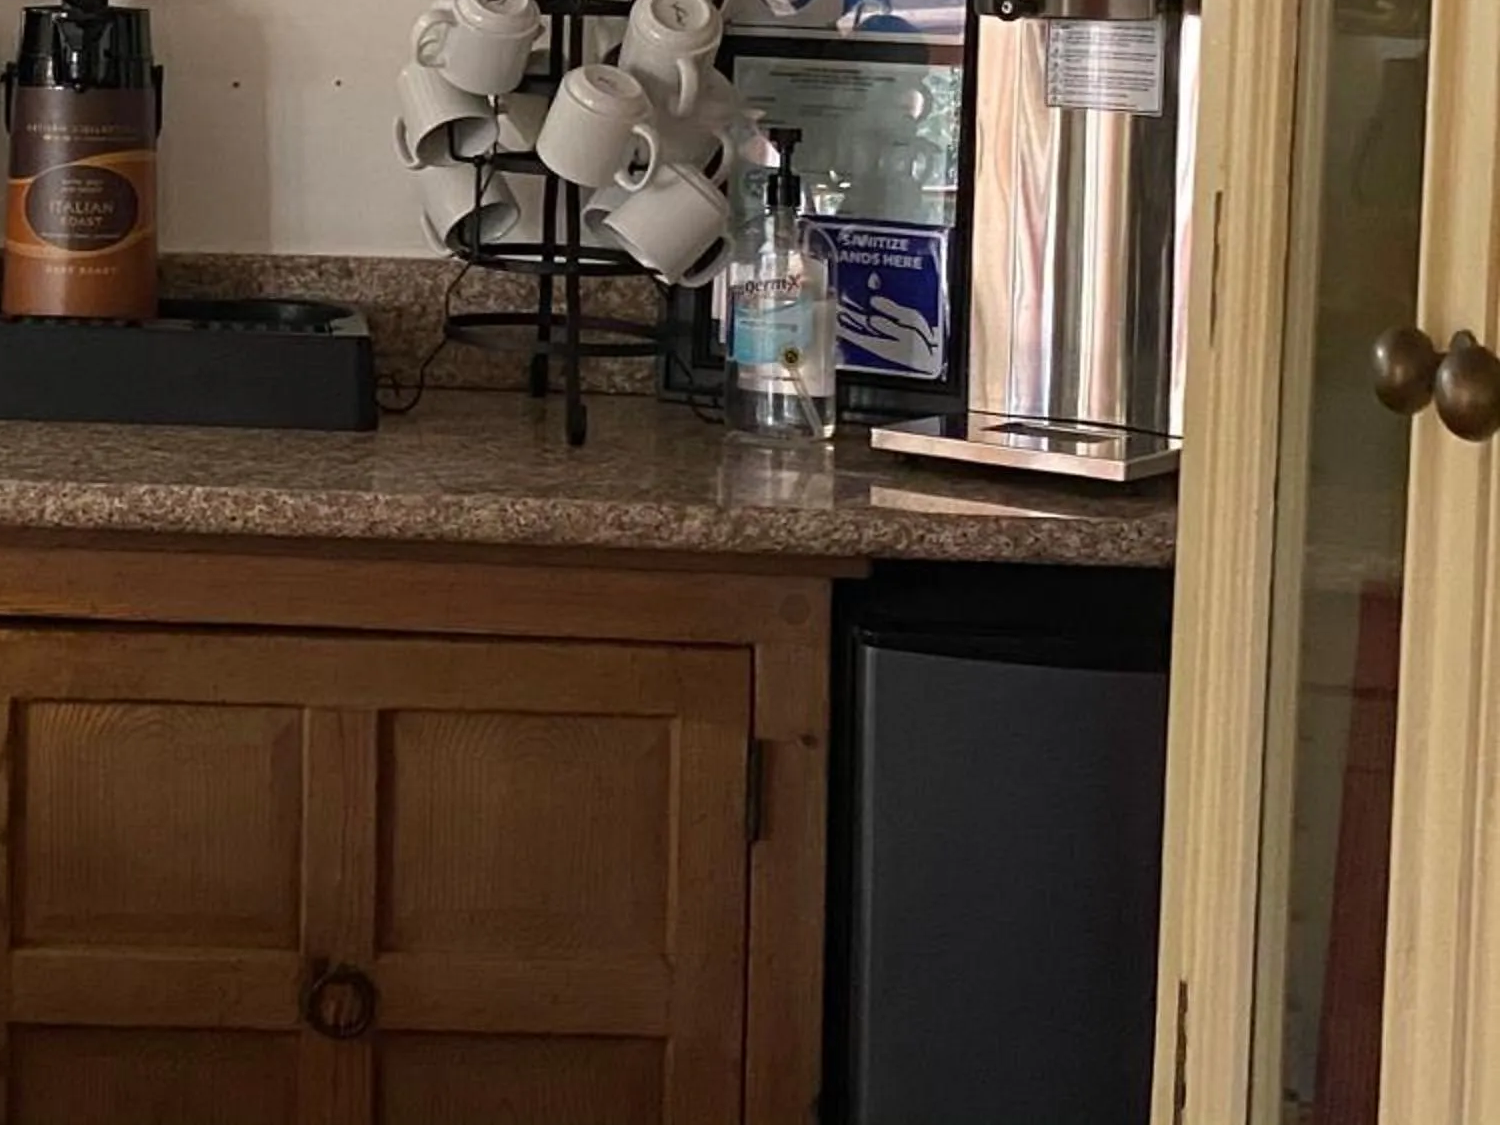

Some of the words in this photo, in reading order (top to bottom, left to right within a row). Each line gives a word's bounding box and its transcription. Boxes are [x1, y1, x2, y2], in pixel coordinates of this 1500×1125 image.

[49, 200, 114, 215] ITALIAN
[836, 250, 880, 266] ANDS
[883, 254, 923, 270] HERE
